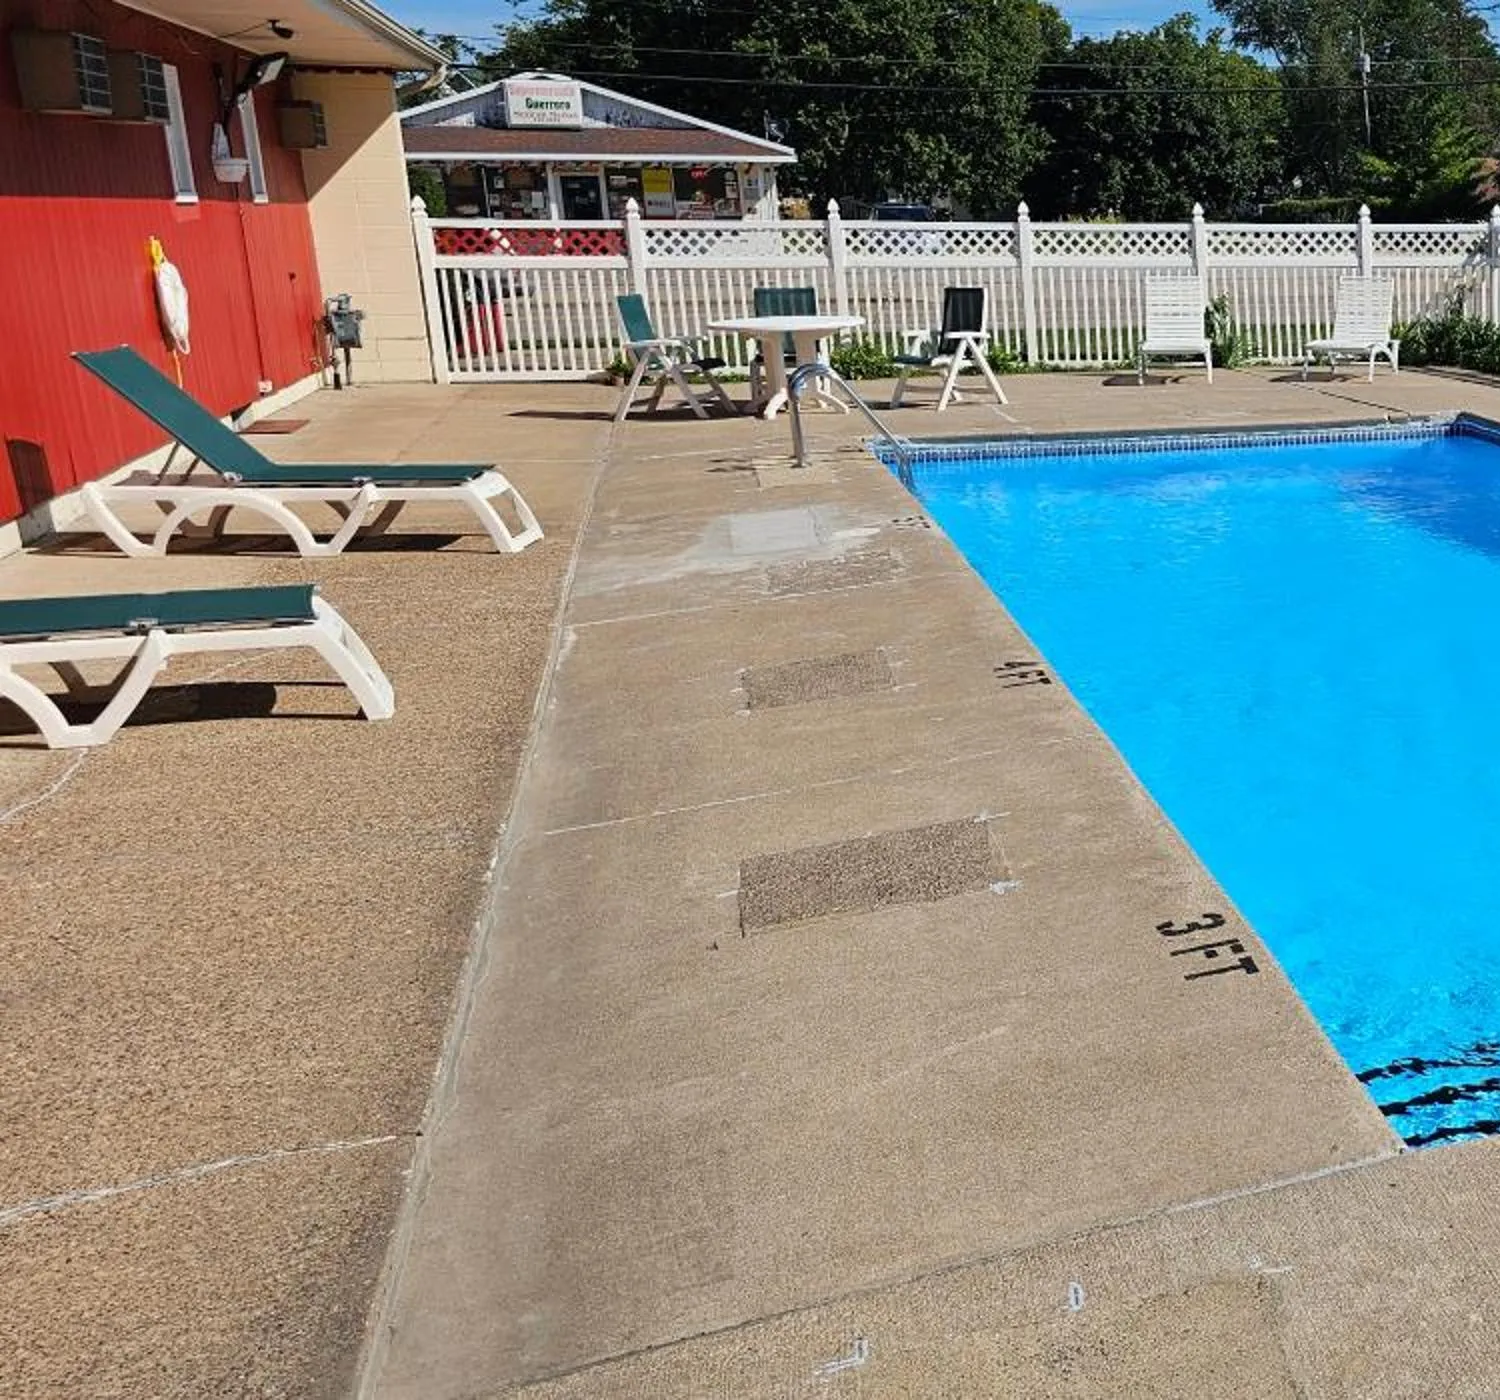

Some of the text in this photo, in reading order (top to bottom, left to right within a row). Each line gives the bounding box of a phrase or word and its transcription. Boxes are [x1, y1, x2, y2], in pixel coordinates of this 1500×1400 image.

[993, 661, 1053, 689] 4 FT
[1156, 913, 1260, 981] 3 FT
